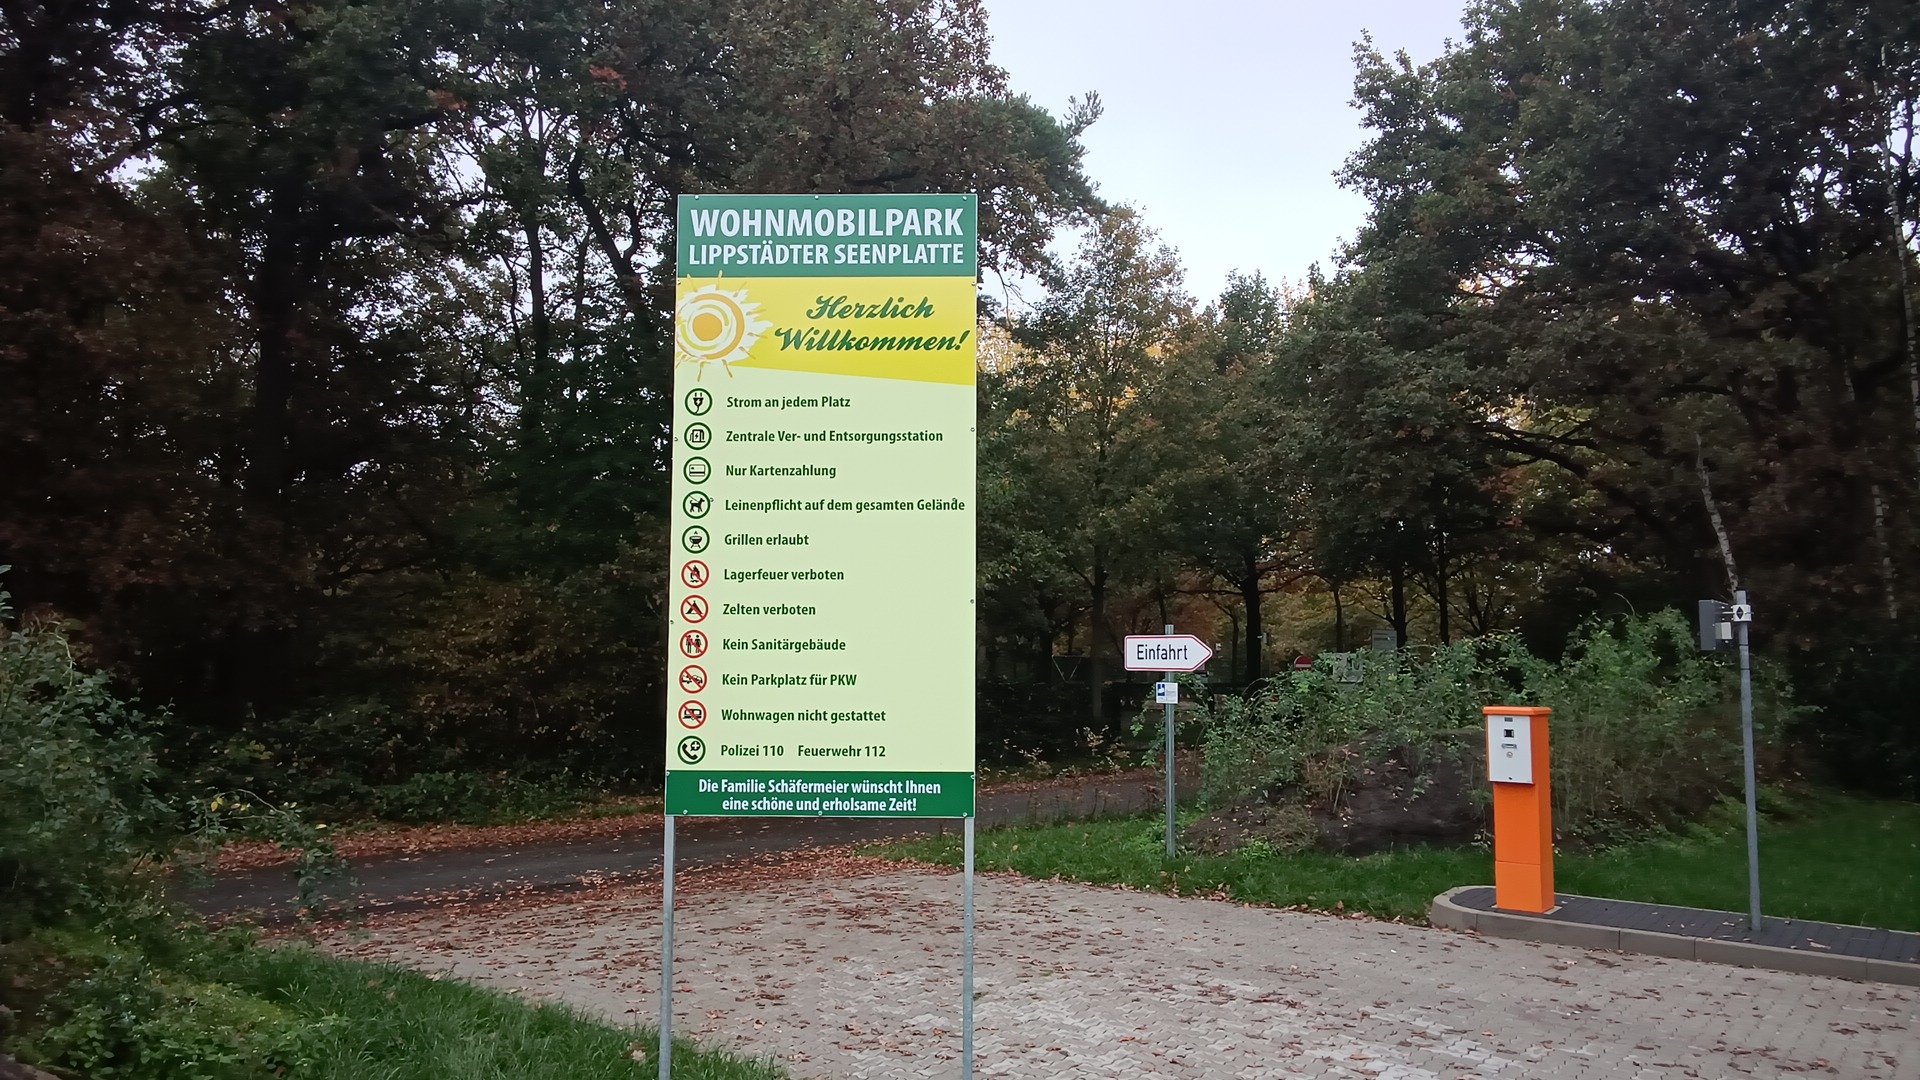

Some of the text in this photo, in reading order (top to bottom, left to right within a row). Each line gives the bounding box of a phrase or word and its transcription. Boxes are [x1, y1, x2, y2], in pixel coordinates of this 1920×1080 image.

[691, 208, 963, 237] WOHNMOBILPARK
[689, 241, 964, 265] LIPPSTÄDTER SEENPLATTE
[806, 296, 934, 319] Herzlich
[775, 327, 970, 351] Willkommen!
[727, 396, 850, 410] Strom an jedem Platz
[726, 430, 943, 444] Zentrale Ver- und Entsorgungsstation
[726, 464, 836, 479] Nur Kartenzahlung
[725, 498, 965, 513] Leinenpflicht auf dem gesamten Gelände
[725, 534, 809, 546] Grillen erlaubt
[724, 568, 844, 583] Lagerfeuer verboten
[723, 604, 816, 615] Zelten verboten
[723, 639, 846, 653] Kein Sanitärgebäude
[1137, 644, 1188, 660] Einfahrt
[722, 674, 857, 688] Kein Parkplatz für PKW
[721, 709, 886, 723] Wohnwagen nicht gestattet
[721, 745, 885, 757] Polizei 110 Feuerwehr 112
[699, 779, 941, 794] Die Familie Schäfermeier wünscht Ihnen
[722, 797, 917, 812] eine schöne und erholsame Zeit!
